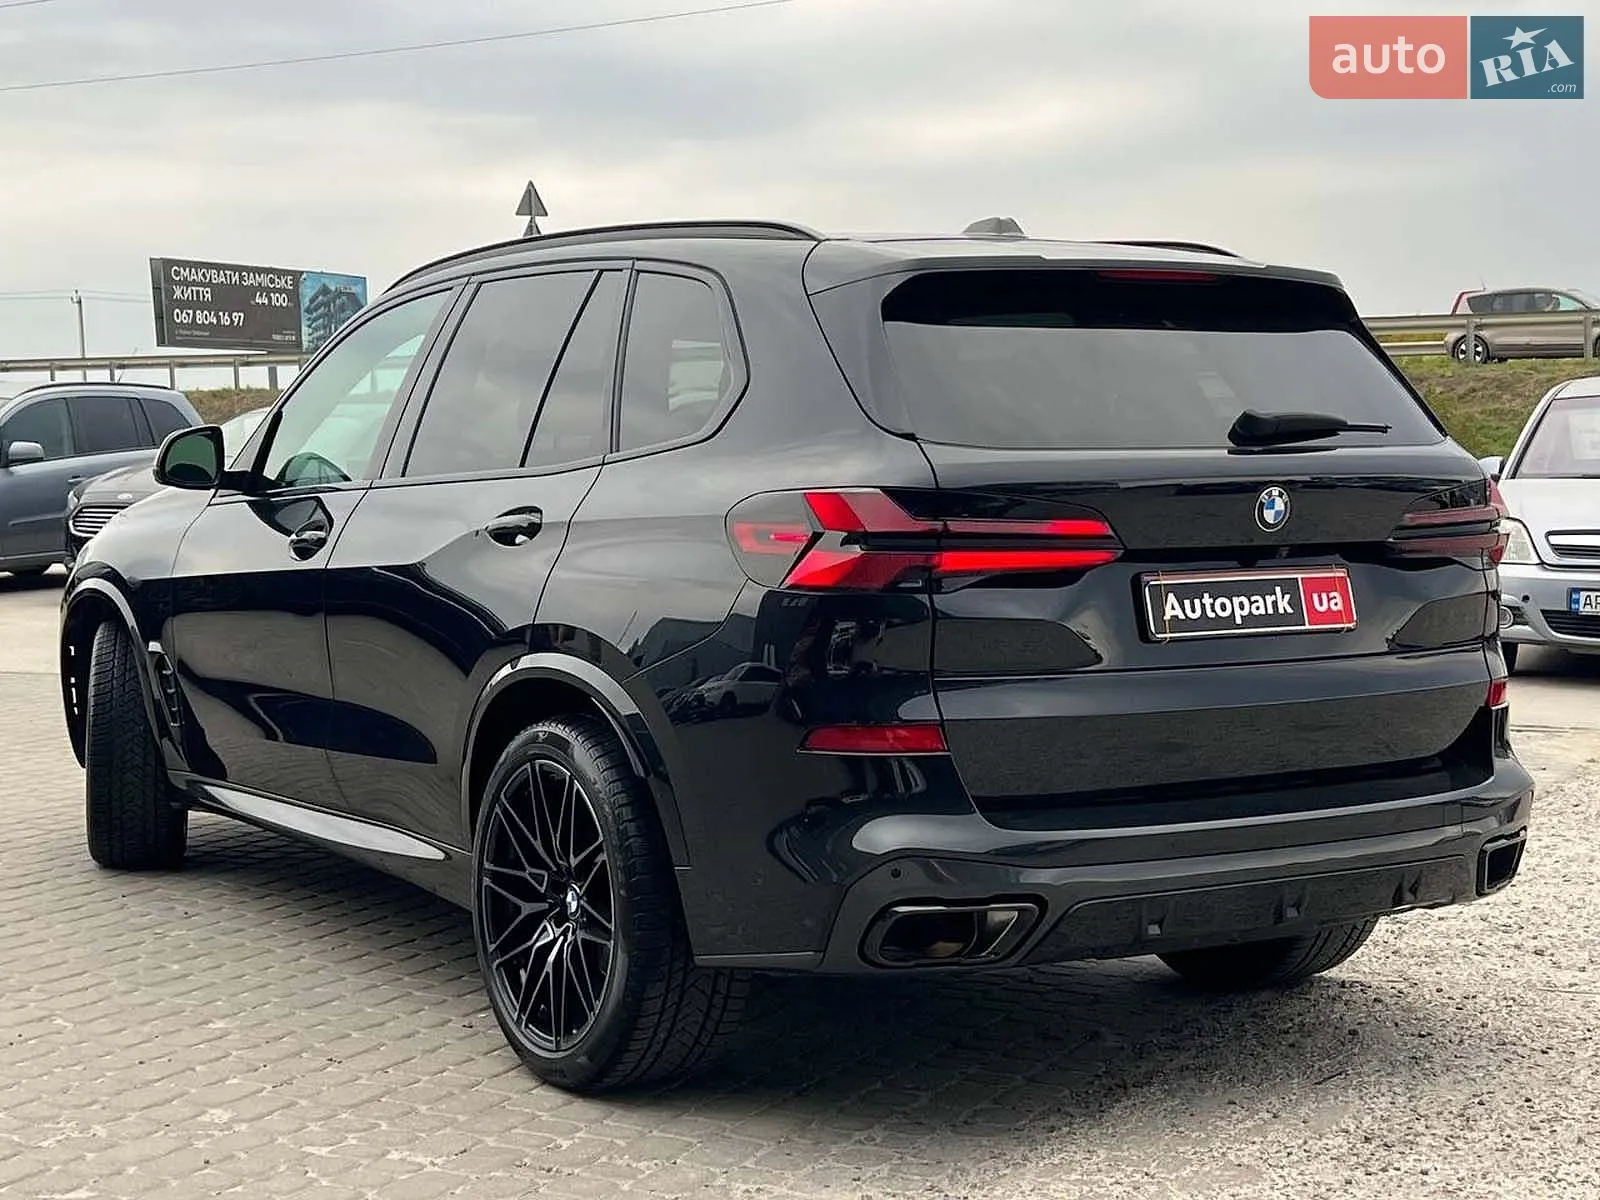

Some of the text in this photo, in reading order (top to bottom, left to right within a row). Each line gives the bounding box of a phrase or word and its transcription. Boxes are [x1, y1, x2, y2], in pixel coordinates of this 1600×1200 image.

[171, 266, 294, 289] СМАКУВАТИ ЗАМІСЬКЕ
[173, 285, 212, 302] ЖИТТЯ
[255, 292, 288, 306] 44 100
[173, 308, 245, 326] 067 804 16 97
[1163, 586, 1344, 624] Autopark ua
